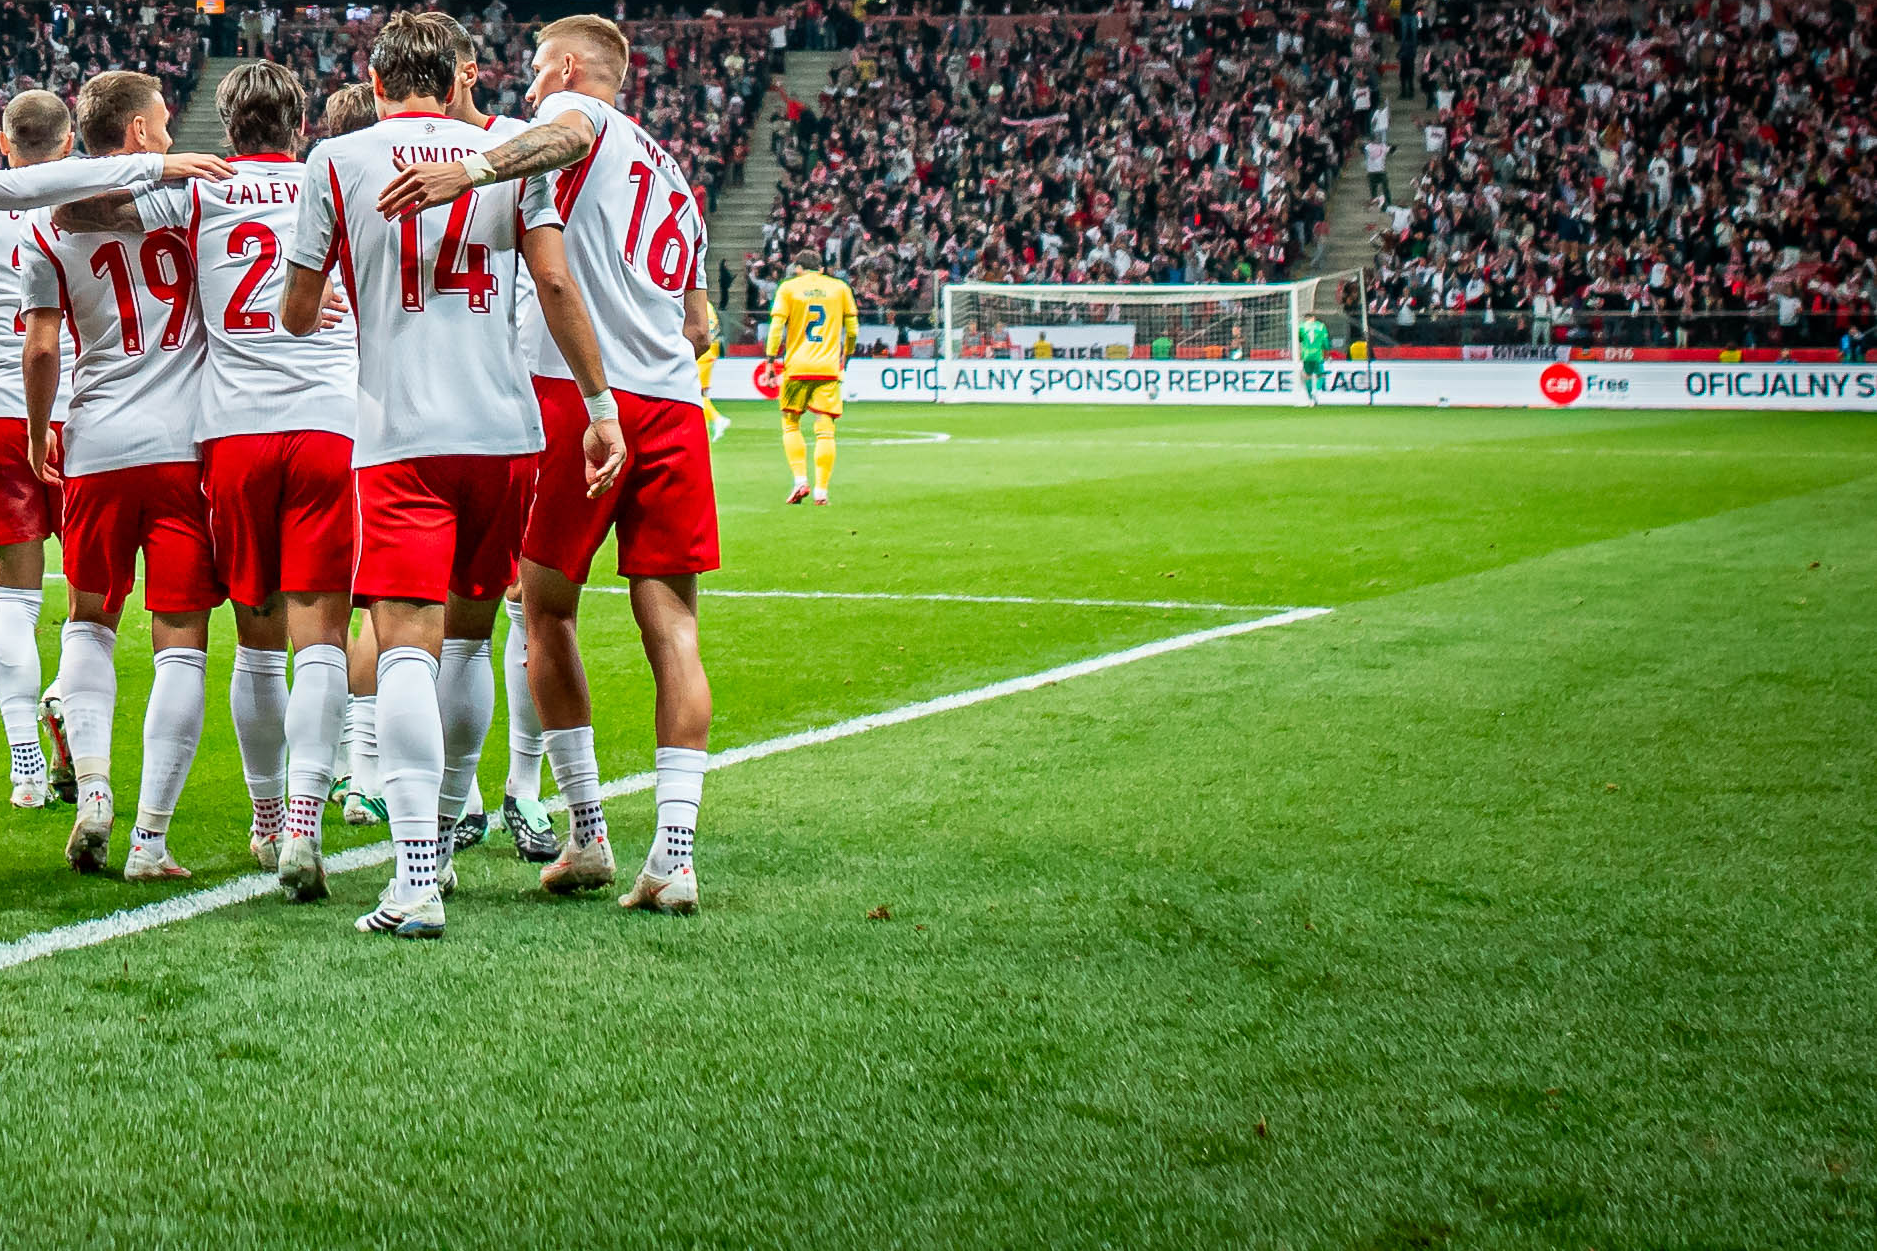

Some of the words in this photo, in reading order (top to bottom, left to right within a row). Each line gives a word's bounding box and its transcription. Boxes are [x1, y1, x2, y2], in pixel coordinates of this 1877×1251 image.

[224, 182, 299, 204] ZALEW
[624, 160, 690, 298] 16
[384, 188, 499, 314] 14
[90, 232, 196, 356] 19
[224, 222, 282, 335] 2
[805, 305, 827, 343] 2
[1030, 367, 1160, 394] SPONSOR
[1168, 368, 1390, 393] REPREZETACJI
[1545, 377, 1578, 394] car
[1587, 374, 1630, 393] Free
[1686, 371, 1850, 398] OFICJALNY
